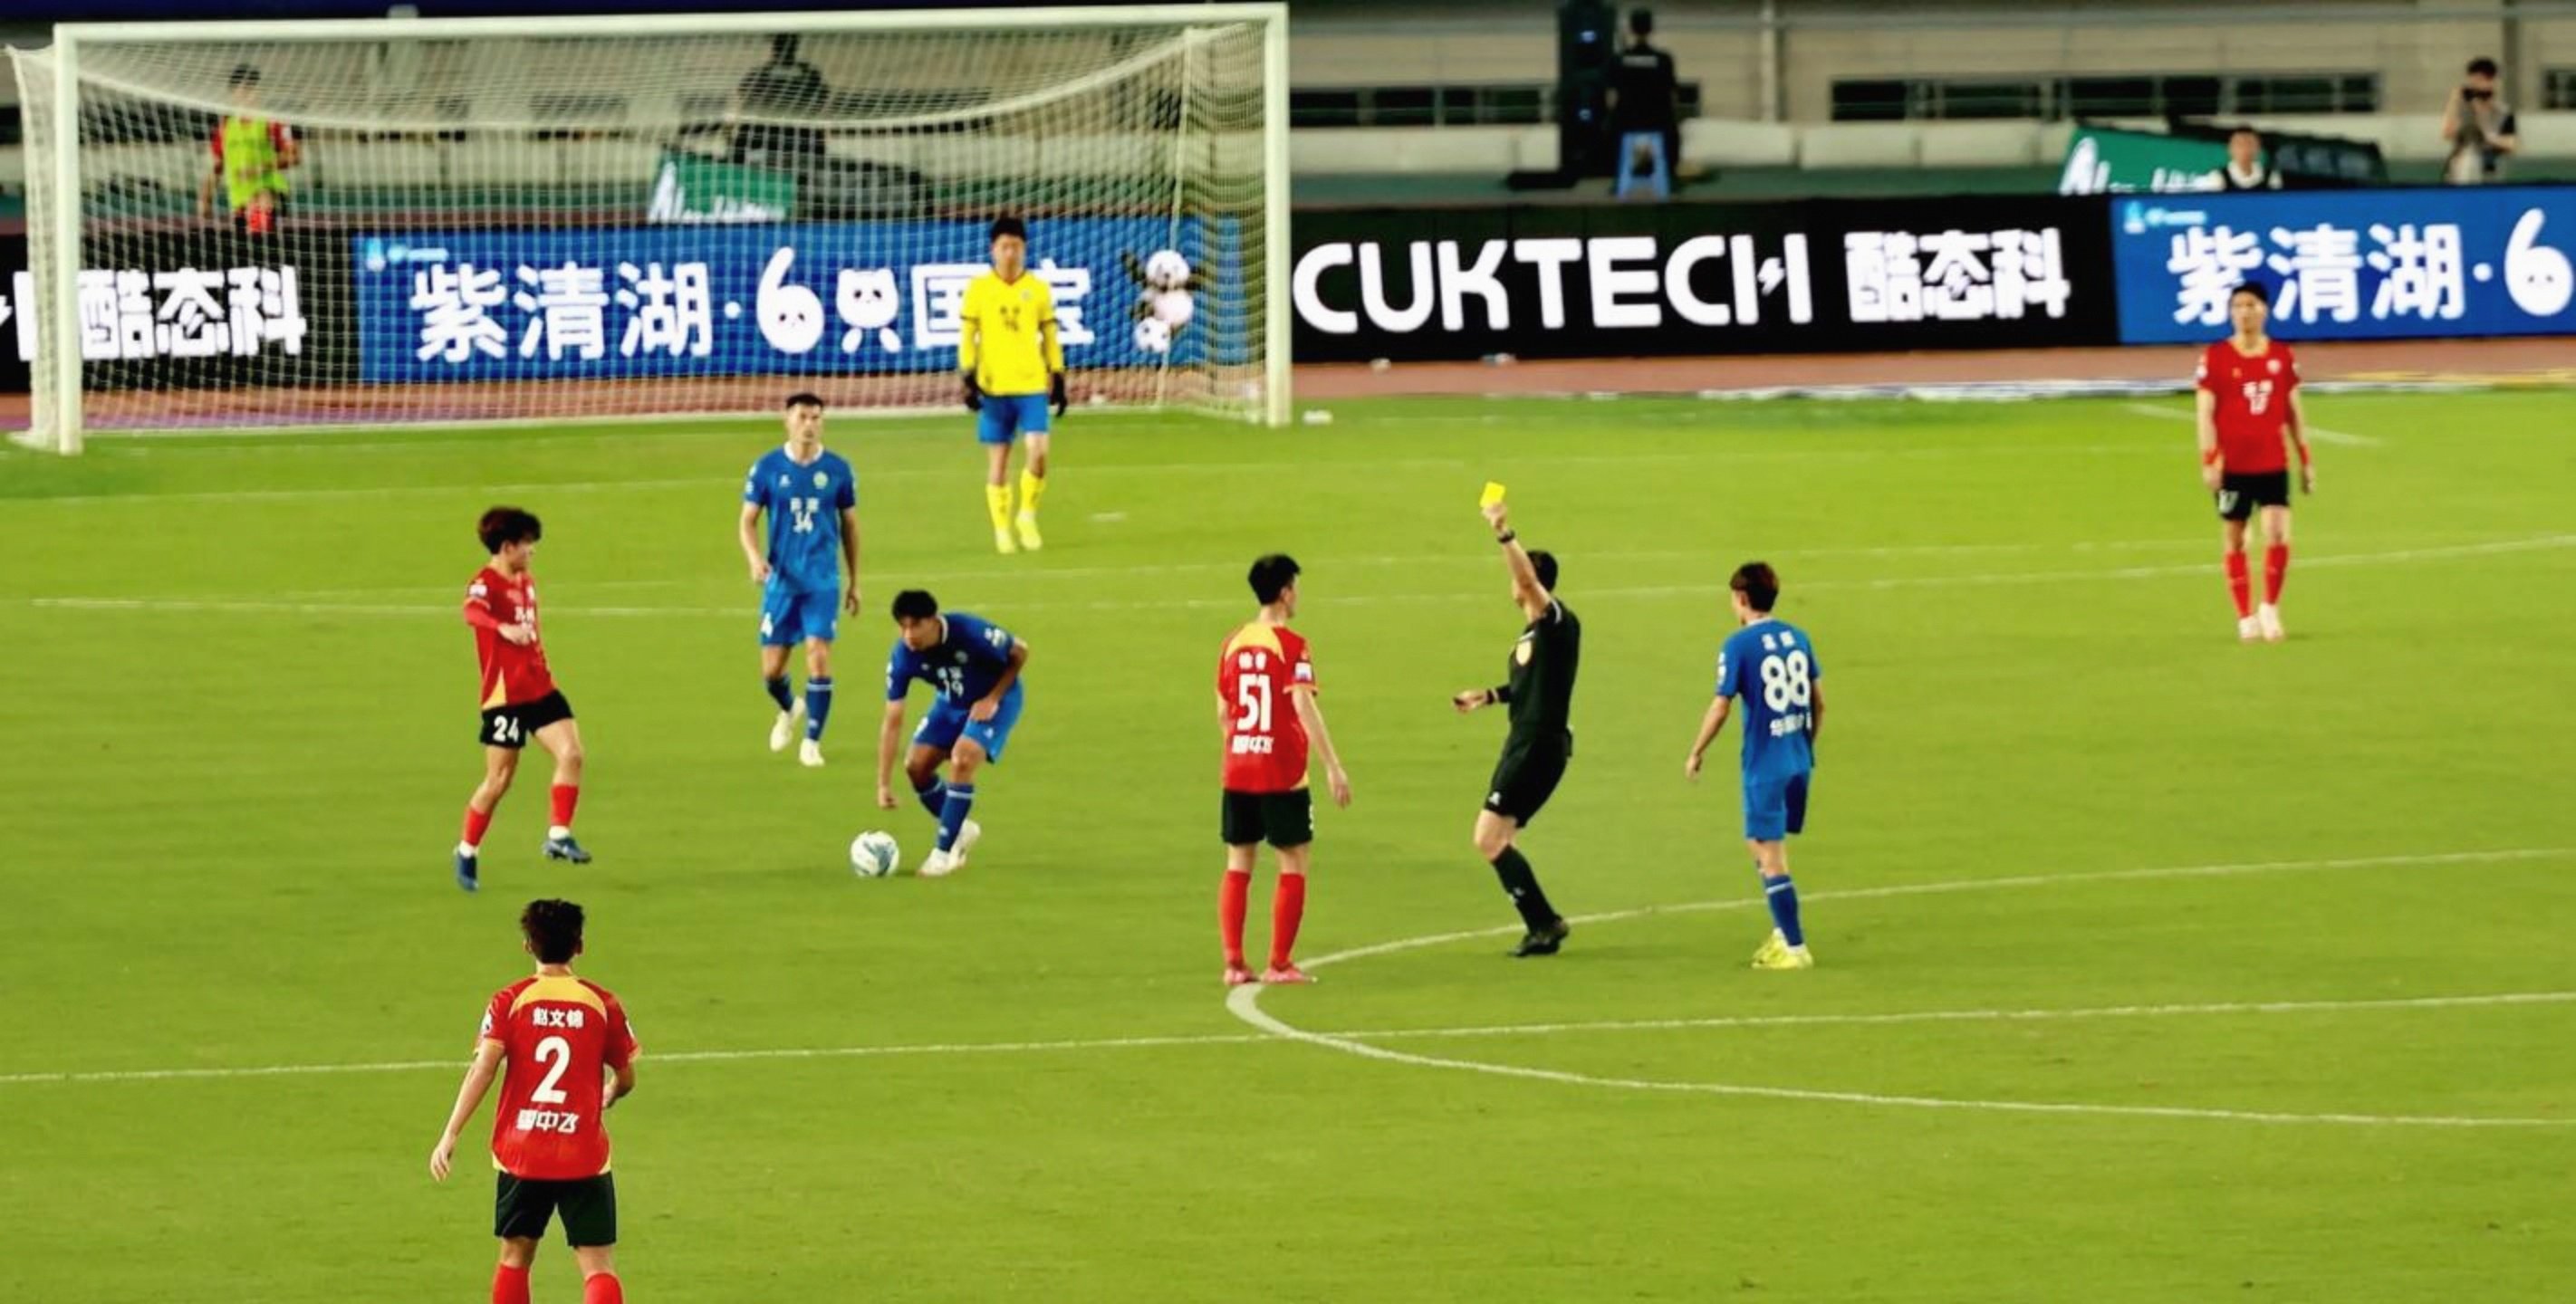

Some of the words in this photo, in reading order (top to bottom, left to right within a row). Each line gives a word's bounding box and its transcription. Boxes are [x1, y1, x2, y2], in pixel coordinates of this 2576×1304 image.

[77, 265, 307, 360] 酷态科
[1293, 233, 1812, 333] CUKTECH
[1844, 227, 2071, 322] 酷态科
[1236, 673, 1272, 733] 51
[1760, 649, 1811, 714] 88
[493, 715, 520, 743] 24
[530, 1035, 571, 1104] 2
